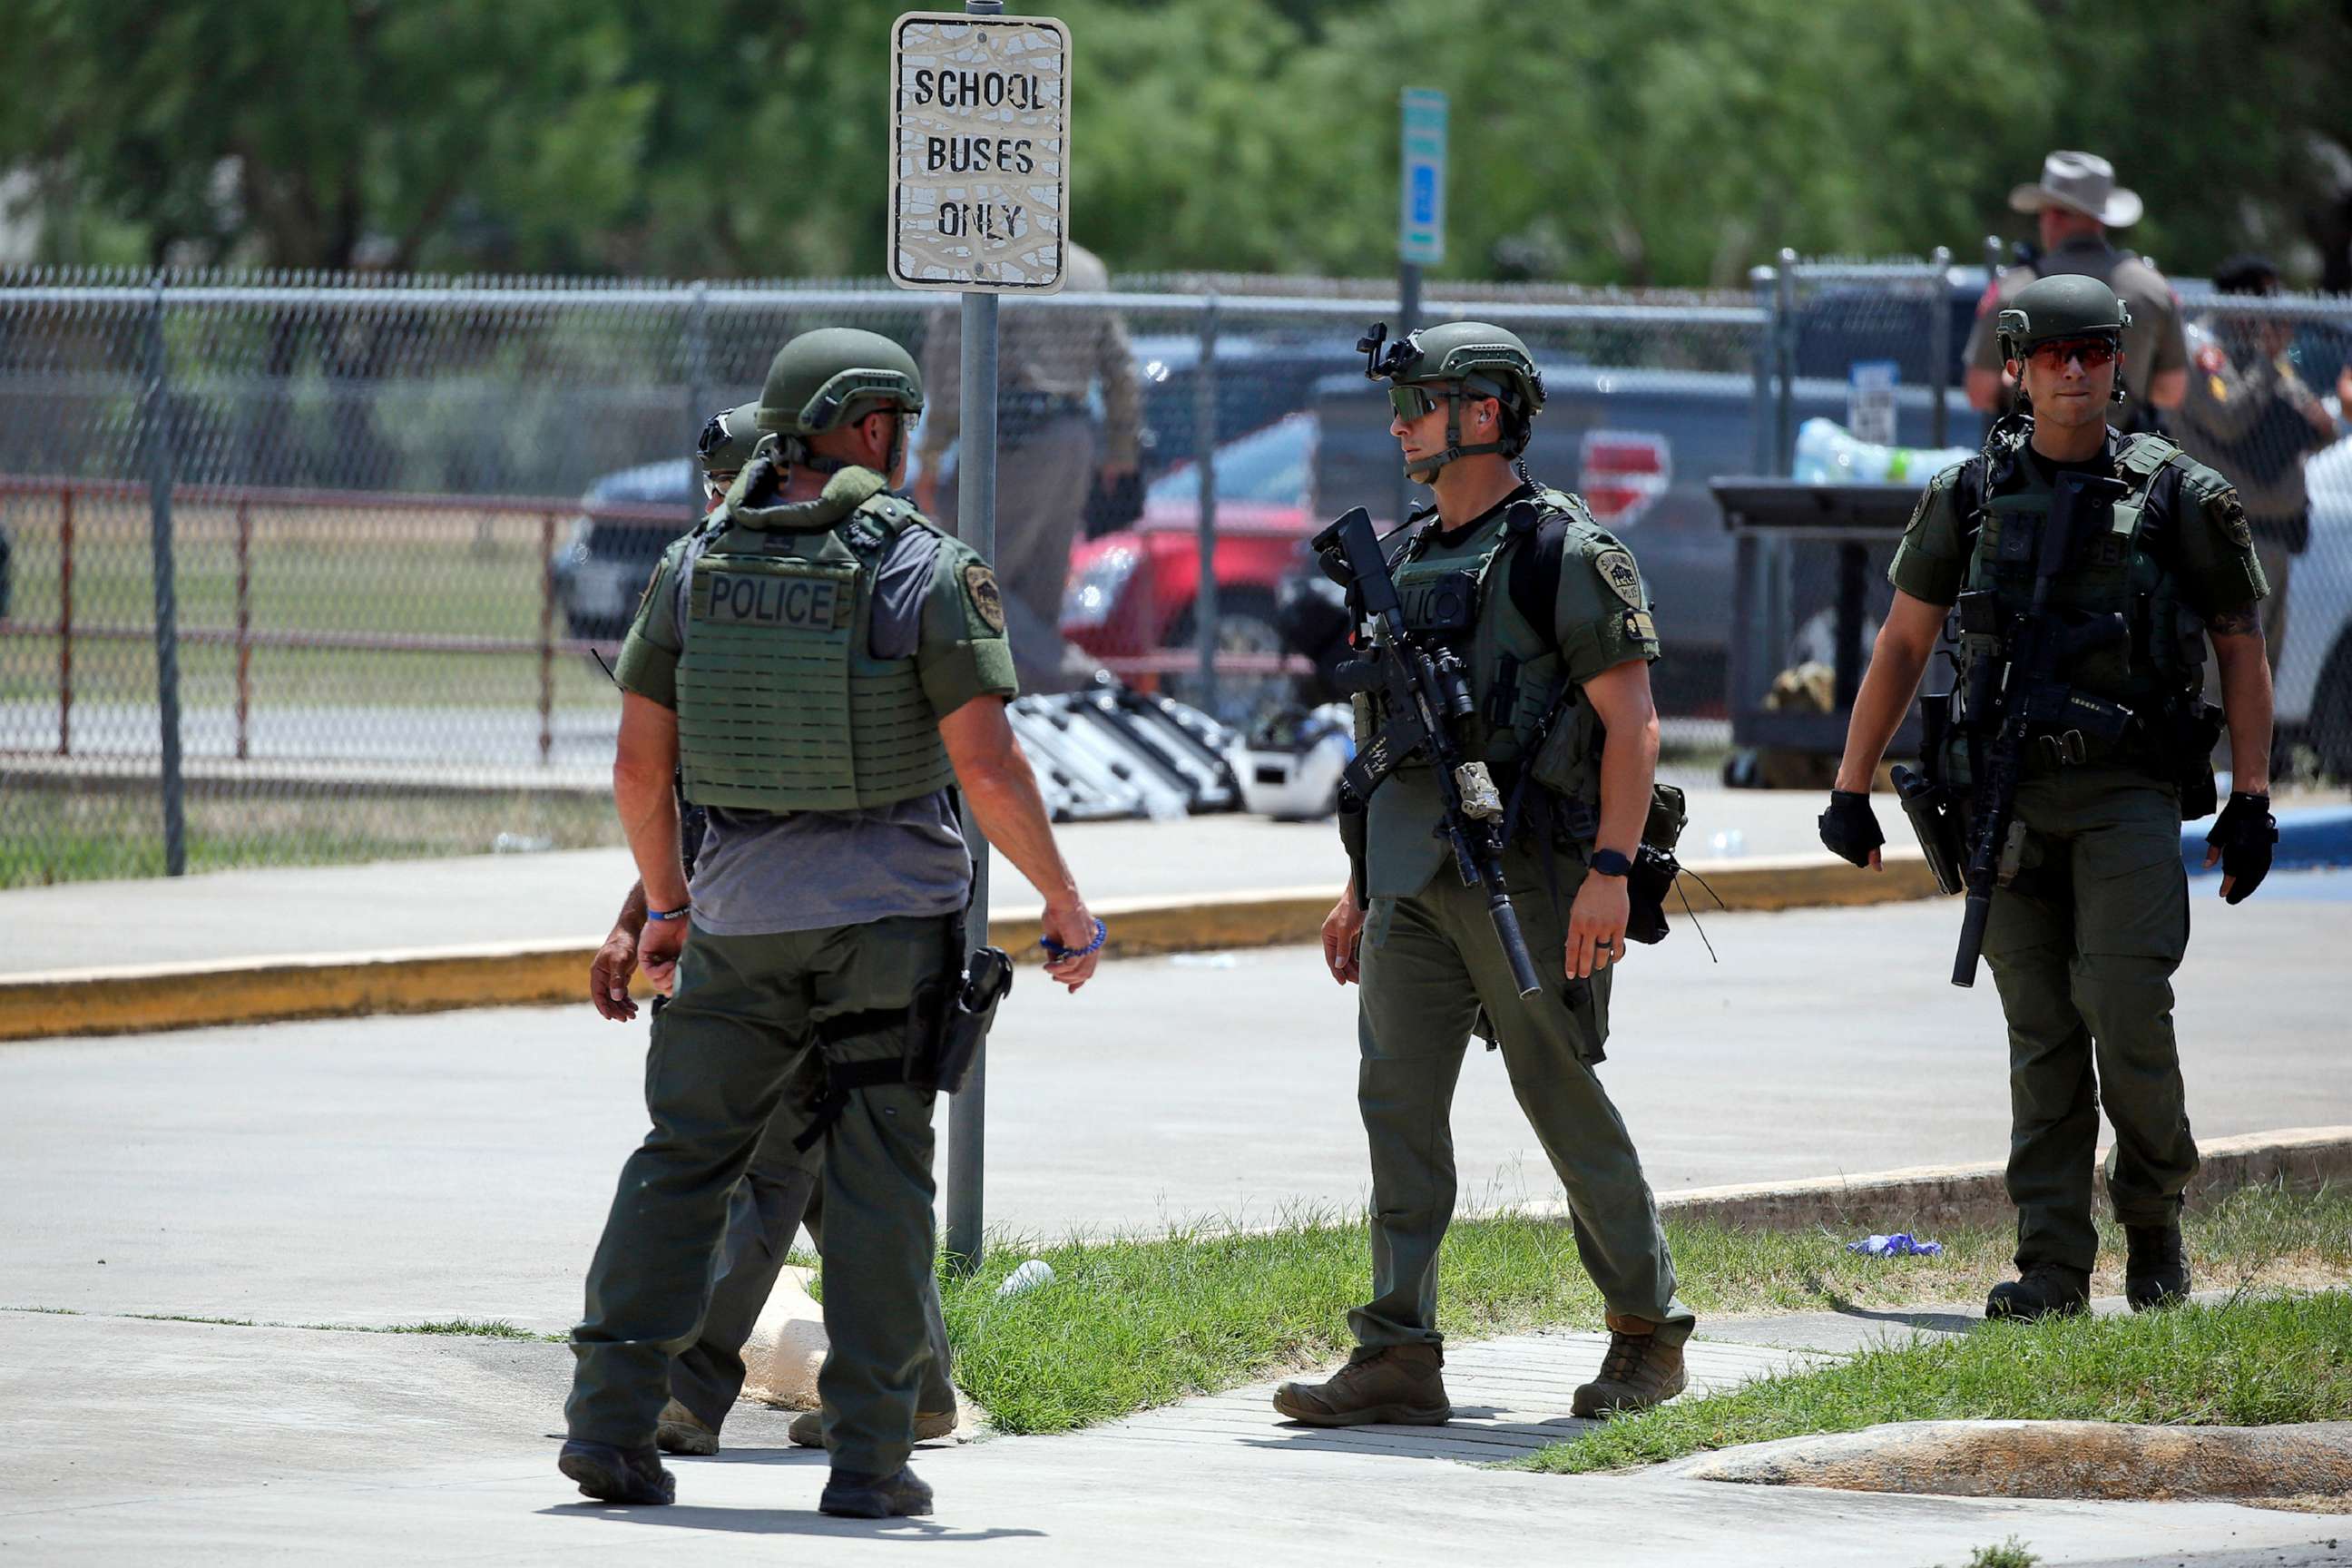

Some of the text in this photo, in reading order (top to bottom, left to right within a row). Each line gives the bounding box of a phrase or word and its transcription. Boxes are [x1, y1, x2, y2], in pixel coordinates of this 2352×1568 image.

[915, 69, 1045, 110] SCHOOL
[927, 136, 1034, 174] BUSES
[938, 201, 1022, 240] ONLY
[710, 576, 833, 625] POLICE
